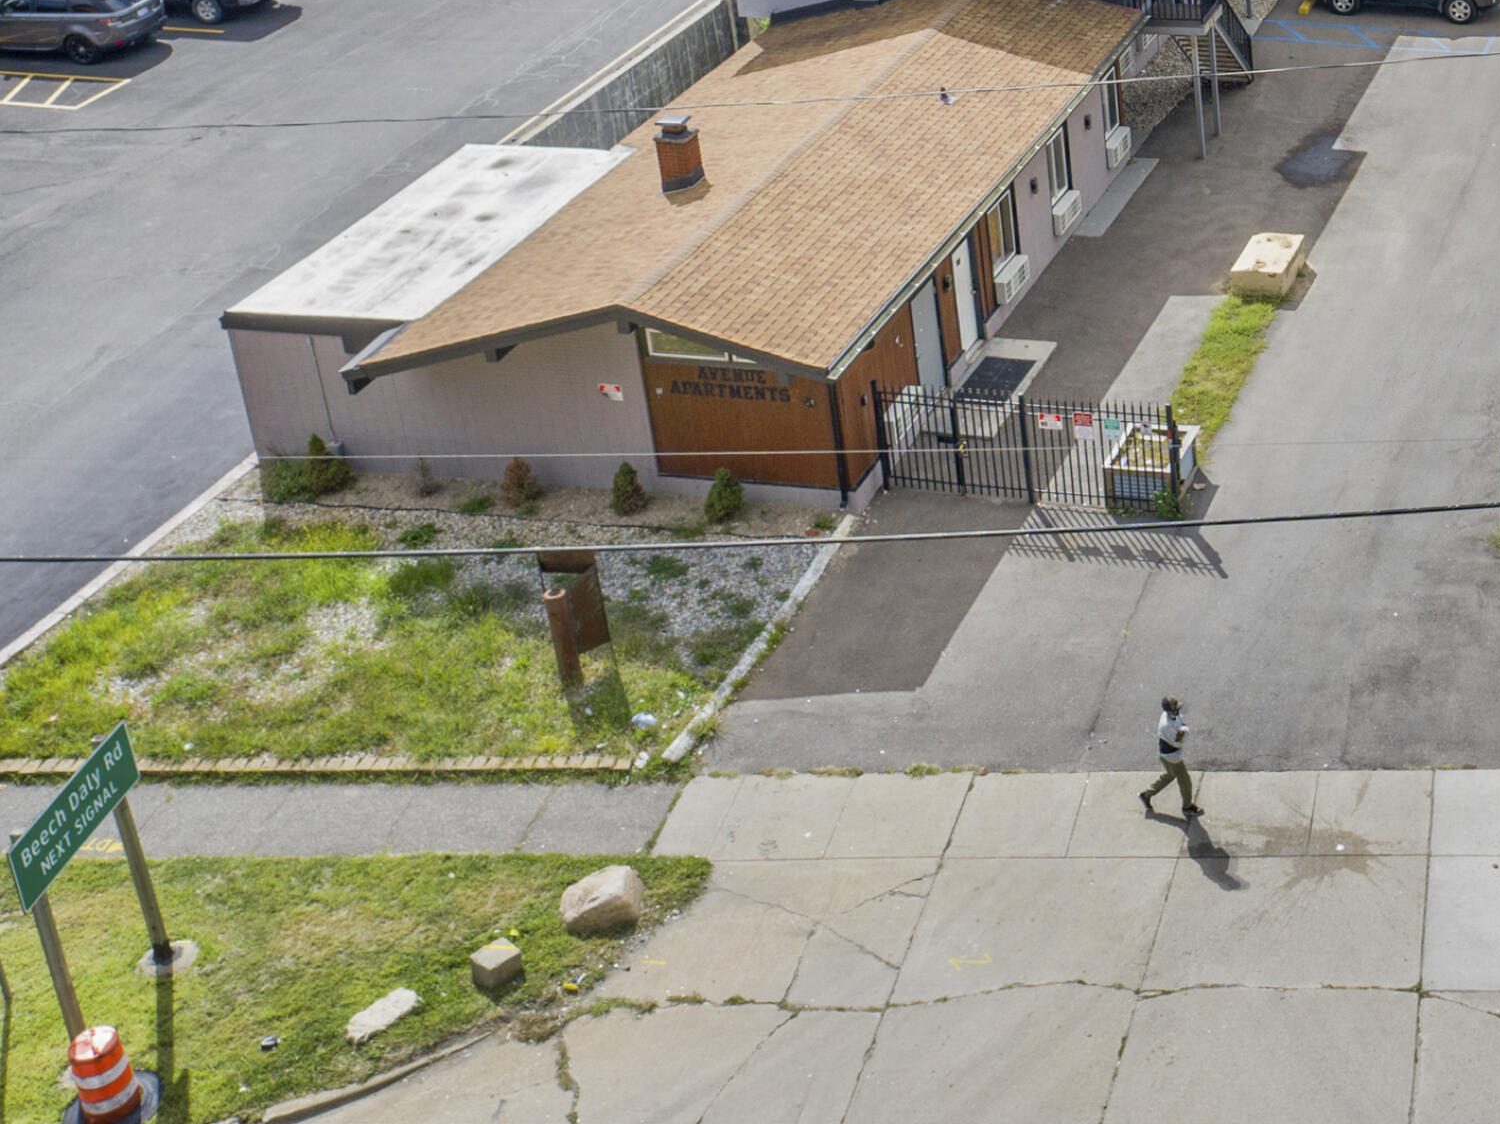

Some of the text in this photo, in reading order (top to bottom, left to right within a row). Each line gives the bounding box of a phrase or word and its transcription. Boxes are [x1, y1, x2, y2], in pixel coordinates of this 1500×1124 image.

[670, 380, 790, 403] APARTMENTS
[698, 366, 767, 384] AVENUE
[20, 740, 123, 868] Beech Daly Rd
[40, 781, 118, 876] NEXT SIGNAL
